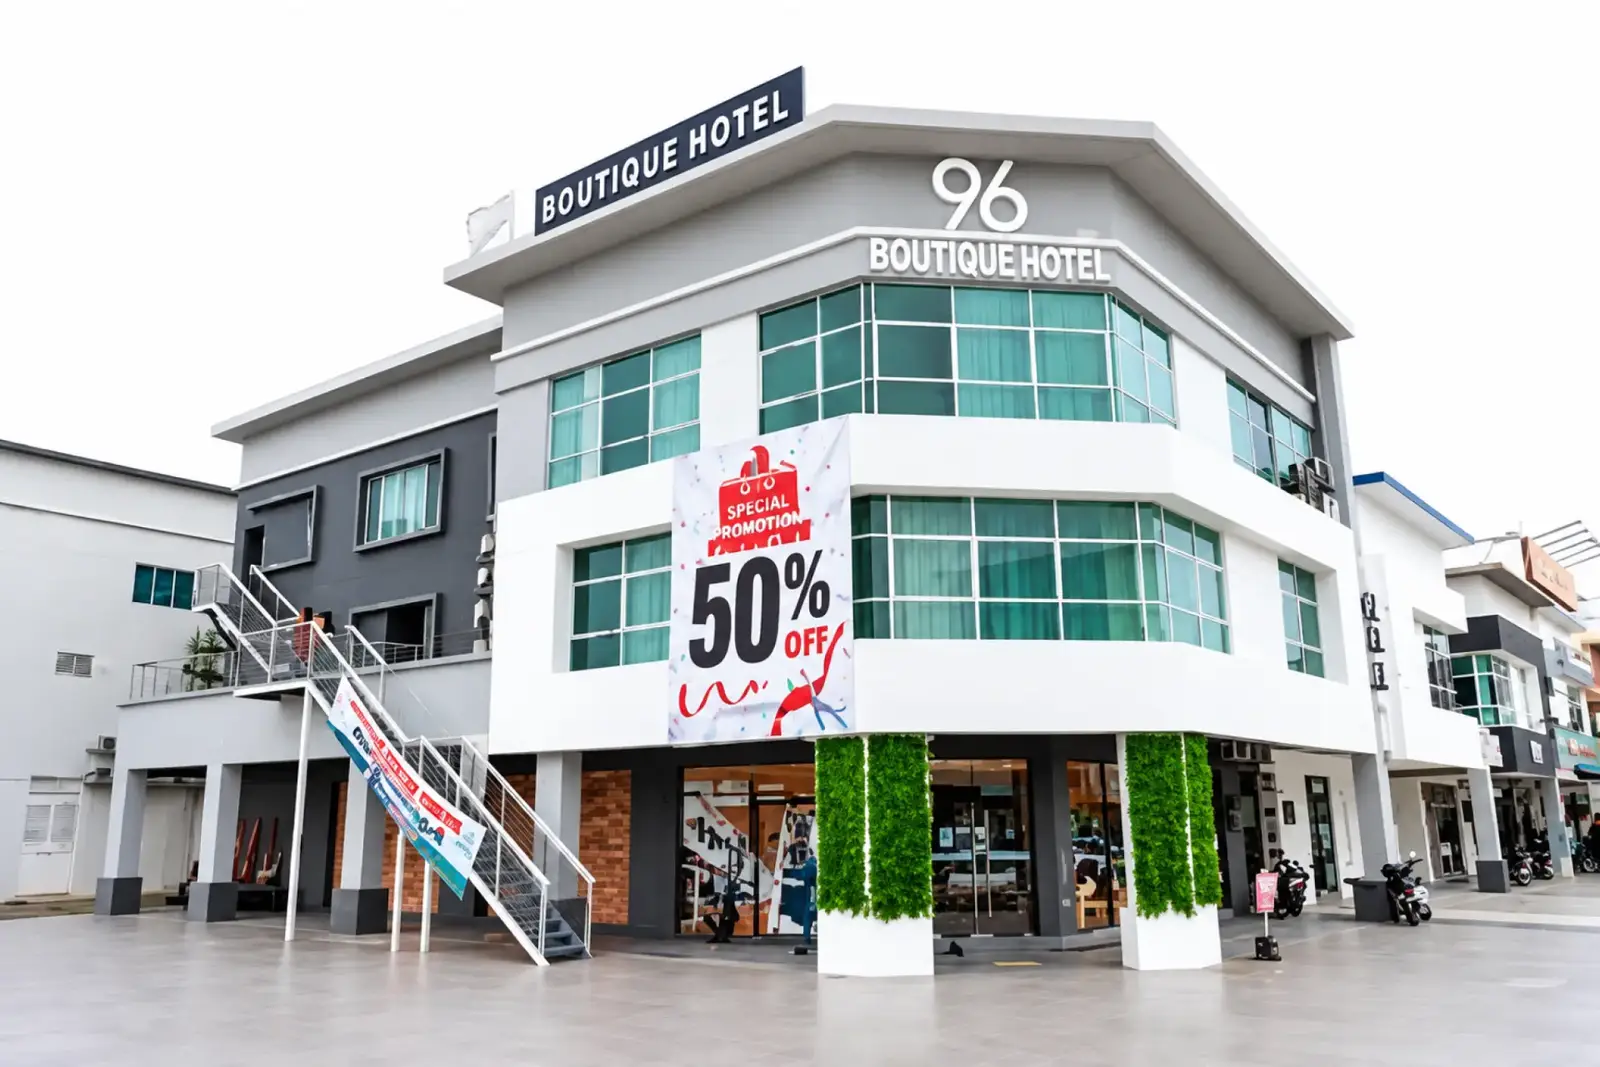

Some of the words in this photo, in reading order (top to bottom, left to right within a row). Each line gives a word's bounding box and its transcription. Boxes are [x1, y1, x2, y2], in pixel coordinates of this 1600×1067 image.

[542, 137, 678, 224] BOUTIQUE
[689, 90, 789, 159] HOTEL
[932, 157, 1028, 232] 96
[870, 237, 1015, 279] BOUTIQUE
[1021, 245, 1111, 282] HOTEL
[712, 510, 803, 541] PROMOTION
[727, 494, 790, 520] SPECIAL
[689, 549, 830, 669] 50%
[784, 624, 829, 659] OFF
